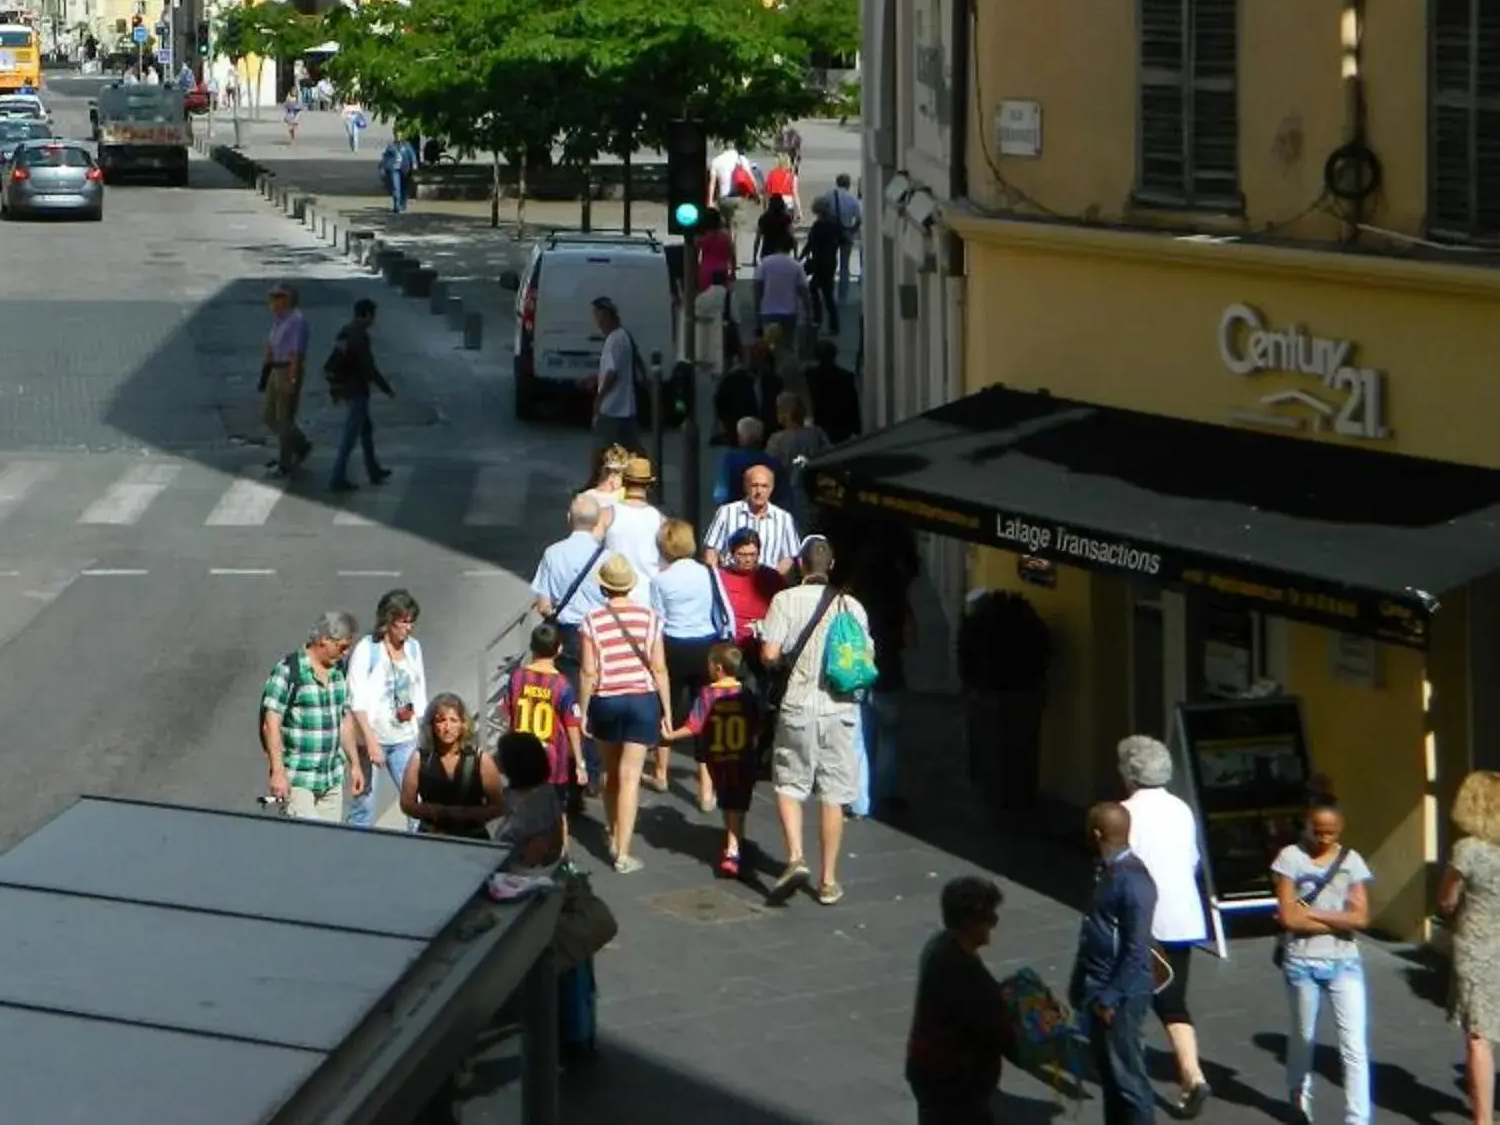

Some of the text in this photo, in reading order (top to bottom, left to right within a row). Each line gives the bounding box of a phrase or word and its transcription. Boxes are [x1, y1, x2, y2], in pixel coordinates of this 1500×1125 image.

[1217, 303, 1351, 389] Century
[1055, 527, 1162, 575] Transactions
[515, 698, 553, 740] 10
[710, 715, 746, 753] 10
